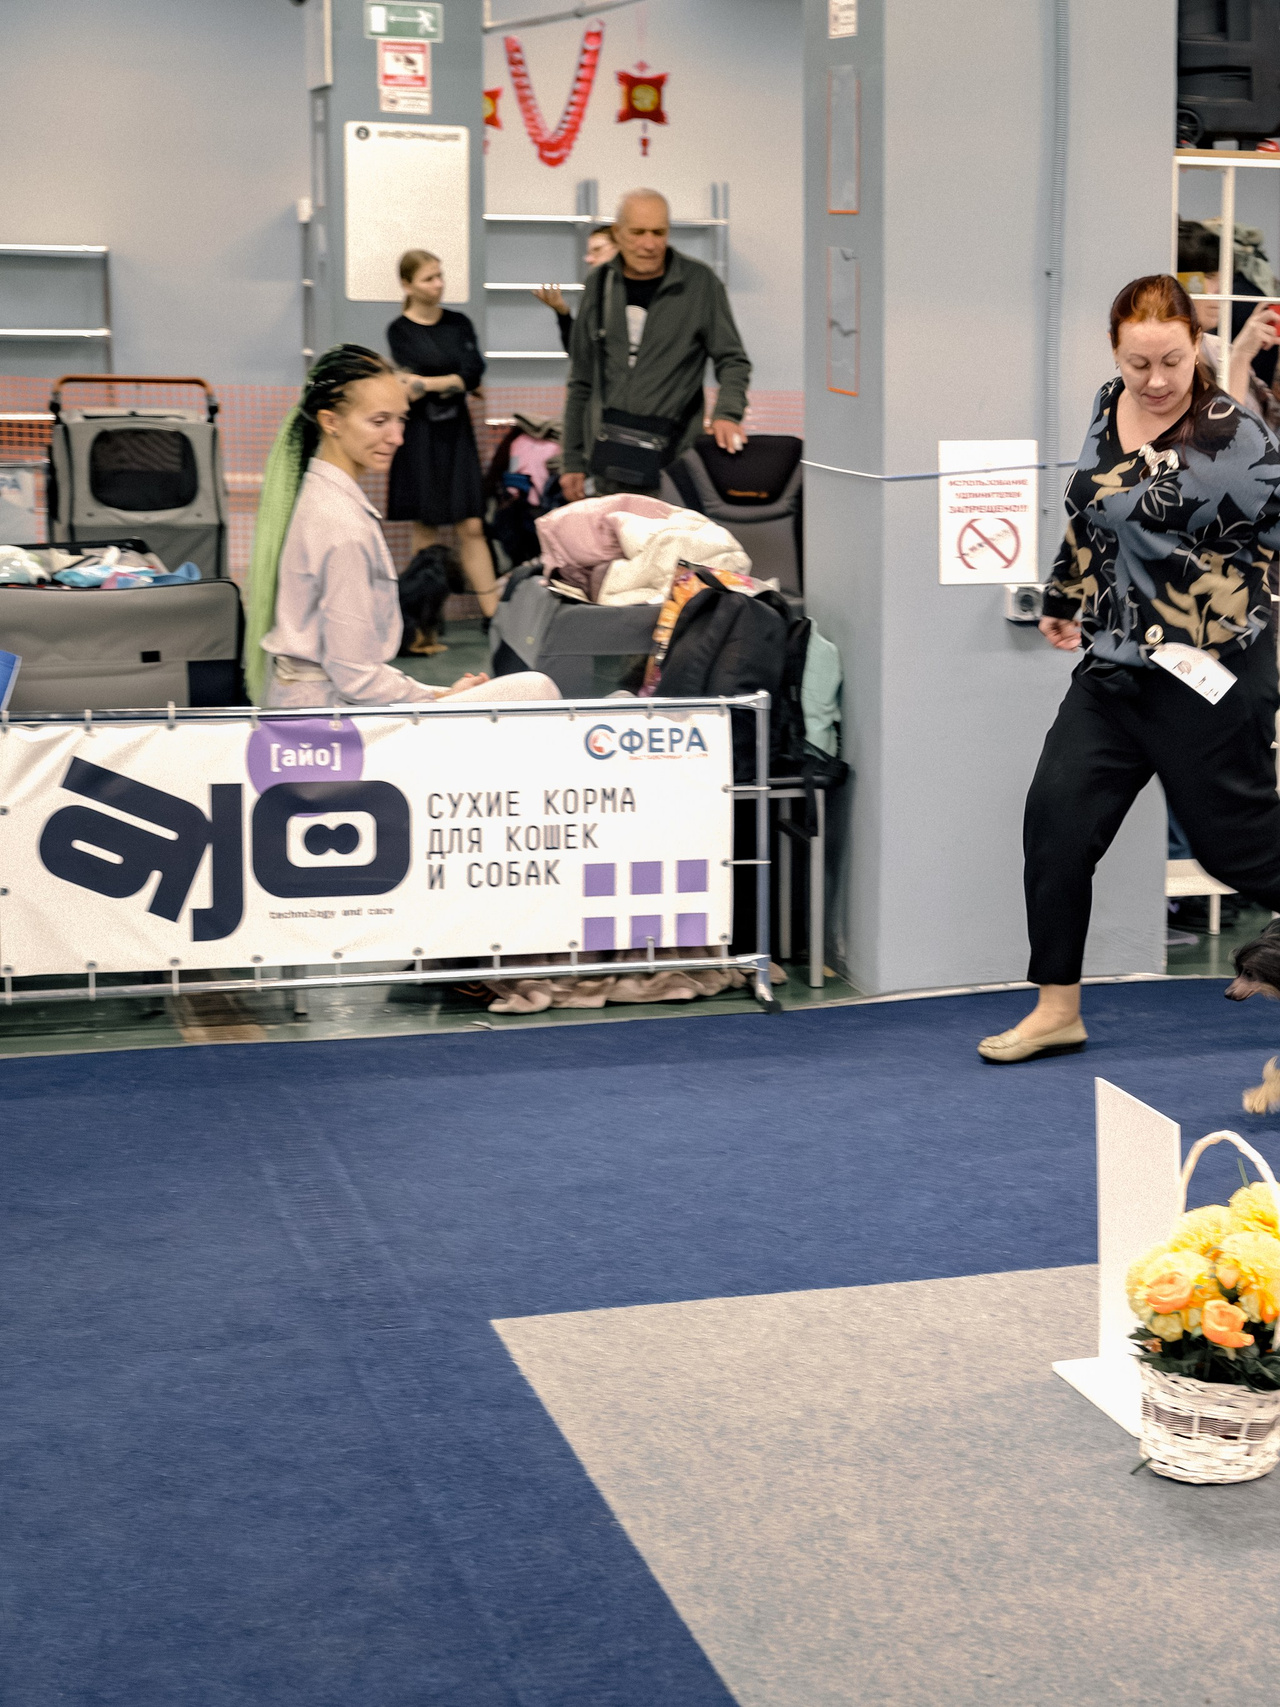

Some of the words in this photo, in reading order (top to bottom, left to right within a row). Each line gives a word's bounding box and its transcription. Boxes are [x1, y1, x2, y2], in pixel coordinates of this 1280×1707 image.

[584, 723, 709, 760] СФЕРА
[427, 790, 520, 819] СУХИЕ
[543, 787, 637, 815] КОРМА
[426, 827, 484, 860] ДЛЯ
[505, 823, 600, 852] КОШЕК
[427, 864, 445, 890] И
[467, 859, 561, 889] СОБАК
